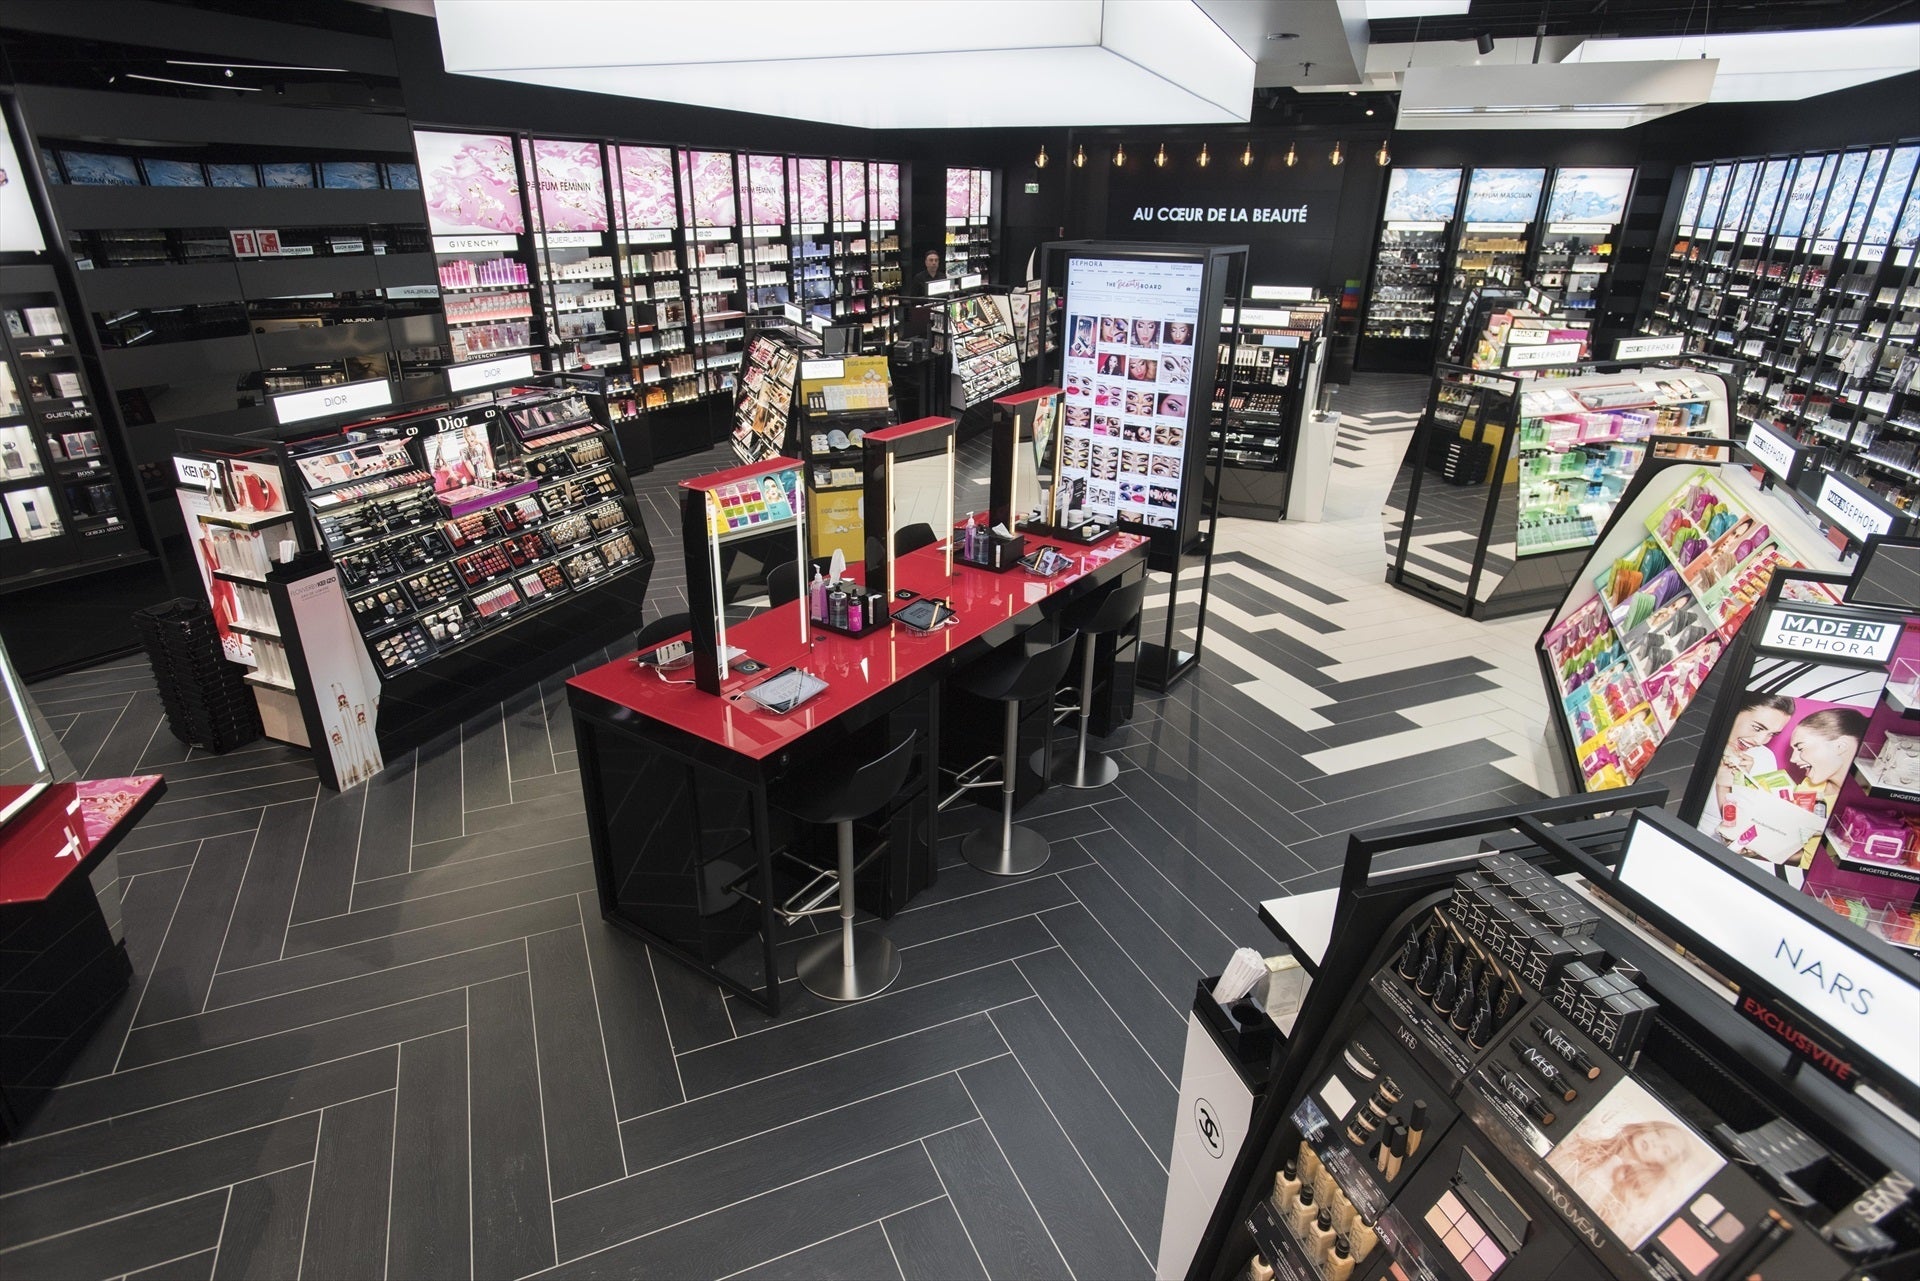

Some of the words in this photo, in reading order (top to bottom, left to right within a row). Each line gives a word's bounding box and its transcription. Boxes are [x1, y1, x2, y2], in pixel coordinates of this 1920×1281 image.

[560, 179, 591, 192] FÉMININ
[1133, 207, 1154, 221] AU
[1157, 207, 1203, 222] CŒUR
[1207, 207, 1226, 222] DE
[1230, 207, 1248, 222] LA
[1252, 205, 1308, 223] BEAUTÉ
[449, 239, 499, 248] GIVENCHY
[547, 236, 585, 244] GUERLAIN
[468, 352, 497, 361] GIVENCHY
[484, 367, 501, 378] DIOR
[324, 395, 348, 407] DIOR
[436, 415, 469, 433] Dior
[182, 464, 217, 480] KENO
[1844, 500, 1879, 534] SEPHORA
[1784, 614, 1852, 637] MADE
[1854, 624, 1882, 641] IN
[1776, 633, 1875, 657] SEPHORA
[1859, 866, 1889, 877] LINGETTES
[1523, 939, 1552, 991] NARS
[1774, 938, 1874, 1015] NARS
[1572, 983, 1602, 1033] NARS
[1592, 1000, 1622, 1050] NARS
[1397, 1025, 1418, 1050] NARS
[1543, 1028, 1576, 1061] NARS
[1743, 997, 1852, 1081] EXCLUSIVITÉ
[1524, 1048, 1559, 1077] NARS
[1247, 1219, 1258, 1234] TEINT
[1547, 1185, 1606, 1248] NOUVEAU
[1375, 1225, 1391, 1245] JOUES
